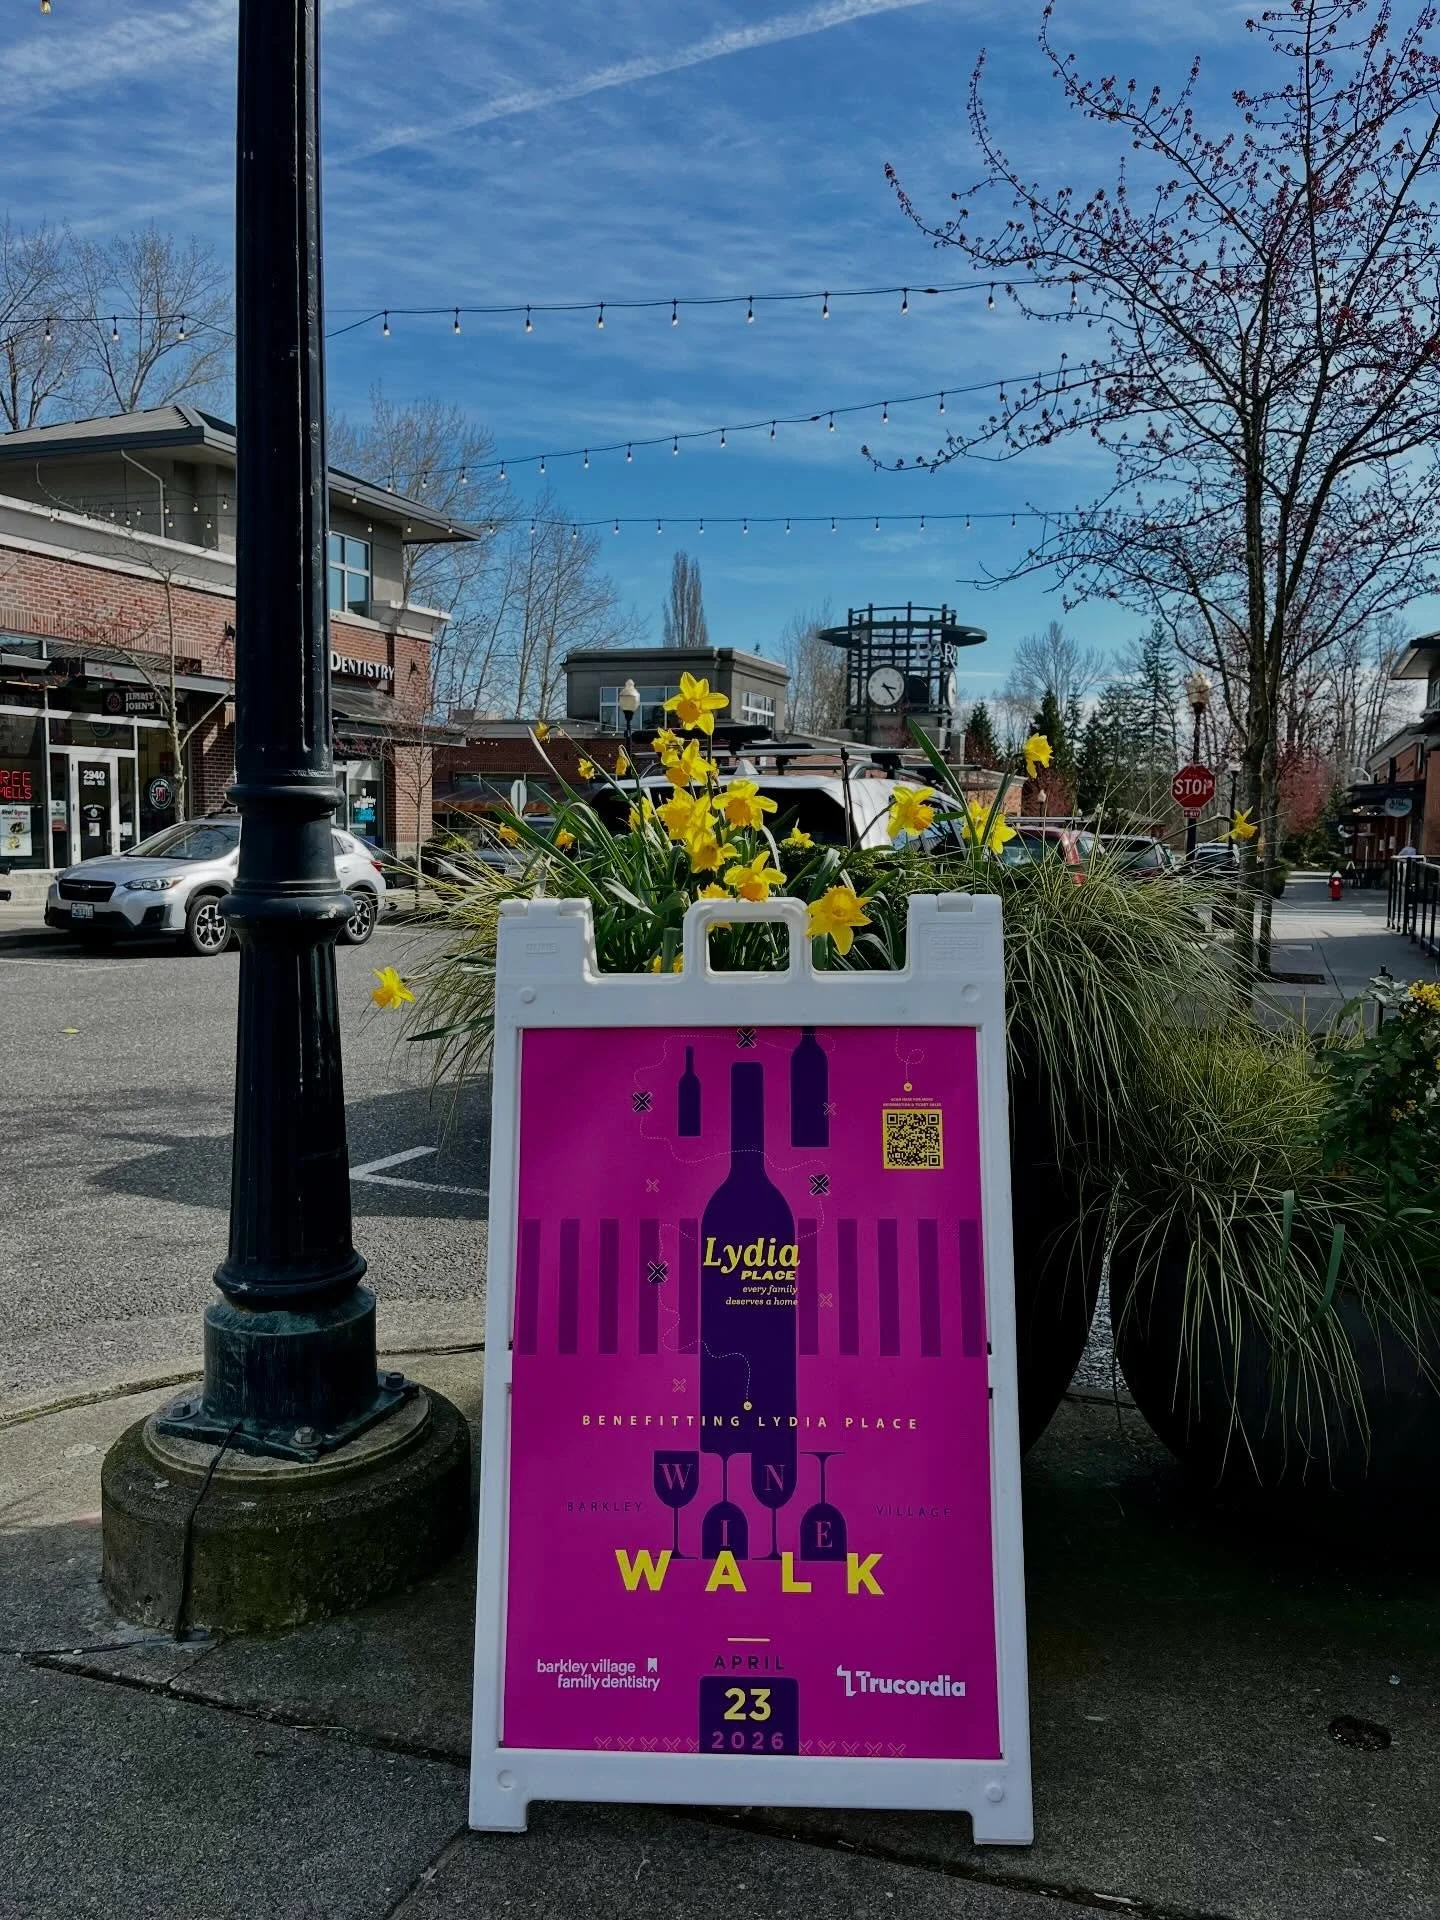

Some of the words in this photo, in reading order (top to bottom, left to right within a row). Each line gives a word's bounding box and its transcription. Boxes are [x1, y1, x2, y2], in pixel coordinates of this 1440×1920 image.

[330, 650, 395, 680] DENTISTRY
[125, 692, 154, 702] JIMMY
[125, 701, 155, 712] JOHN'S
[83, 769, 106, 780] 2940
[1174, 778, 1213, 795] STOP
[703, 1237, 801, 1274] Lydia
[741, 1270, 797, 1280] PLACE
[742, 1287, 767, 1295] every
[767, 1285, 798, 1295] family
[725, 1297, 764, 1305] deserves
[773, 1297, 798, 1305] home
[582, 1415, 740, 1427] BENEFITTING
[758, 1416, 827, 1428] LYDIA
[845, 1417, 917, 1430] PLACE
[567, 1501, 642, 1512] BARKLEY
[876, 1505, 952, 1518] VILLAGE
[615, 1549, 885, 1596] WALK
[537, 1658, 589, 1676] barkley
[591, 1658, 636, 1676] village
[714, 1655, 785, 1671] APRIL
[558, 1674, 600, 1690] family
[601, 1674, 660, 1692] dentistry
[855, 1670, 966, 1697] Trucordia
[724, 1687, 772, 1721] 23
[711, 1730, 784, 1750] 2026
